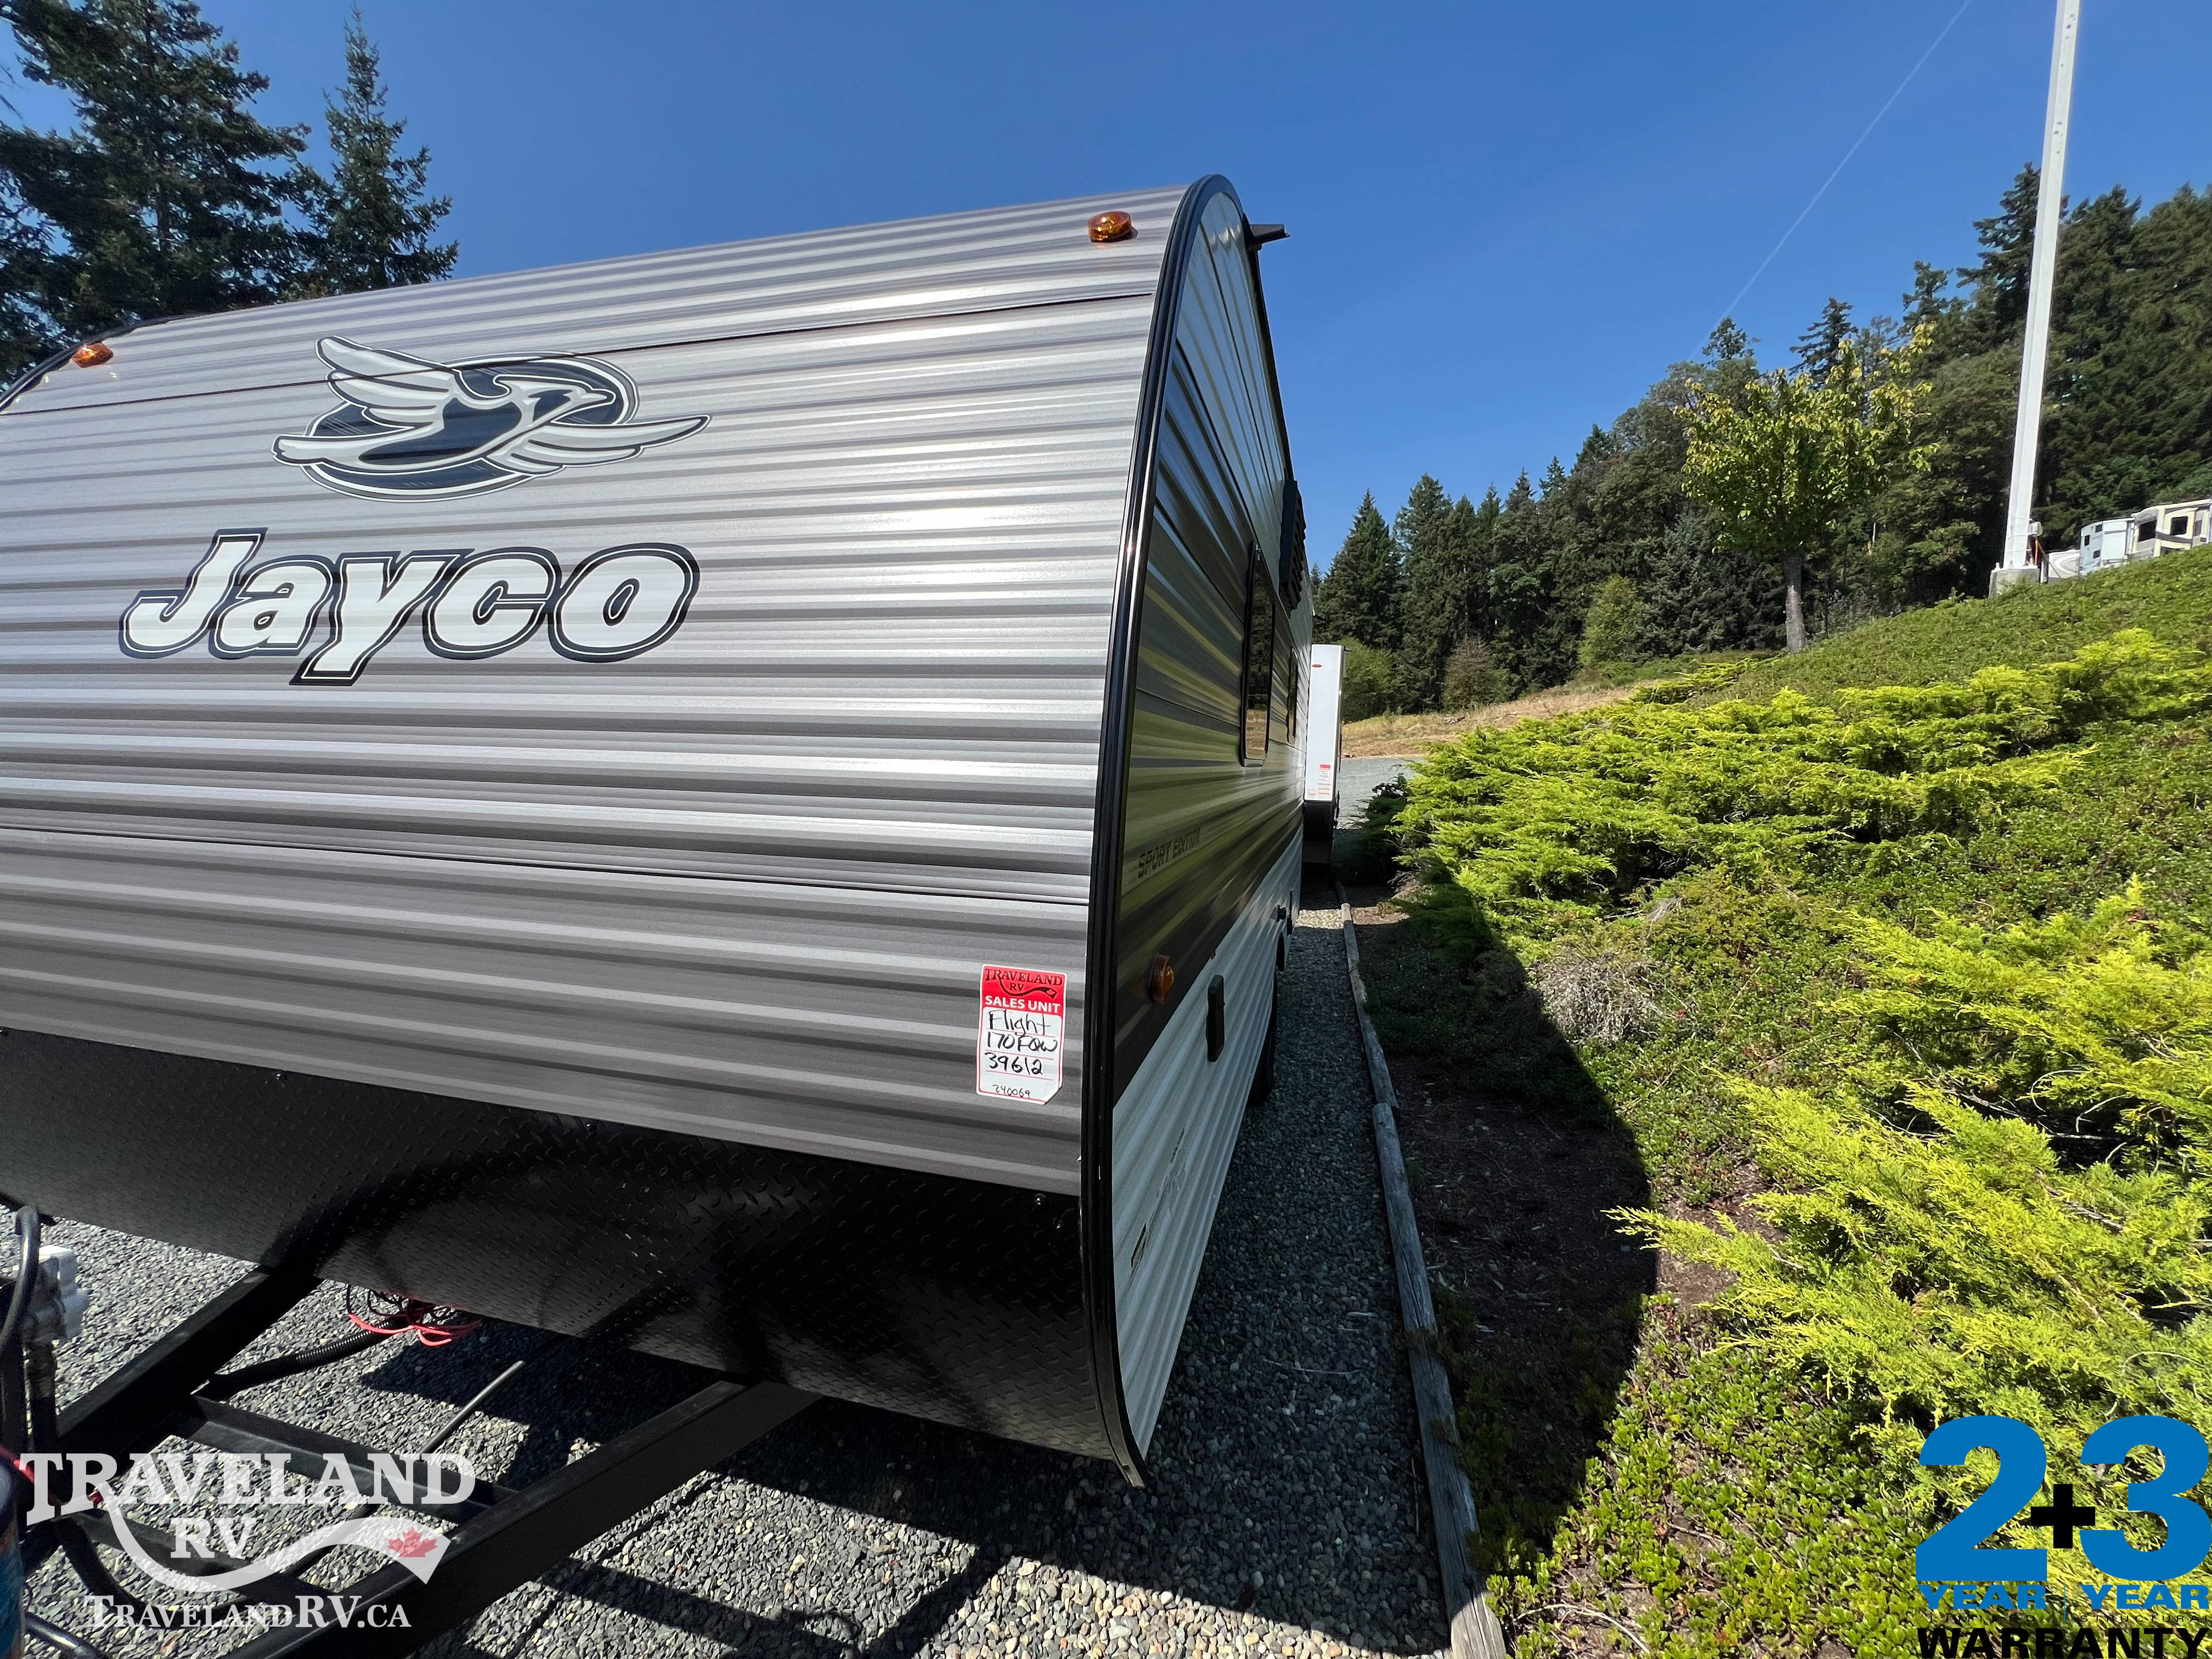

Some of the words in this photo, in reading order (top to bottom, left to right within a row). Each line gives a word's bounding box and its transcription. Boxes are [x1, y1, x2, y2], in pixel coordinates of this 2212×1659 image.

[119, 527, 699, 686] Jayco
[1137, 839, 1172, 878] SPORT
[984, 968, 1063, 986] TRAVELAND
[1009, 983, 1024, 992] RV
[985, 995, 1025, 1009] SALES
[1028, 1000, 1061, 1014] UNIT
[988, 1009, 1051, 1036] Flight
[984, 1052, 1043, 1076] 39612
